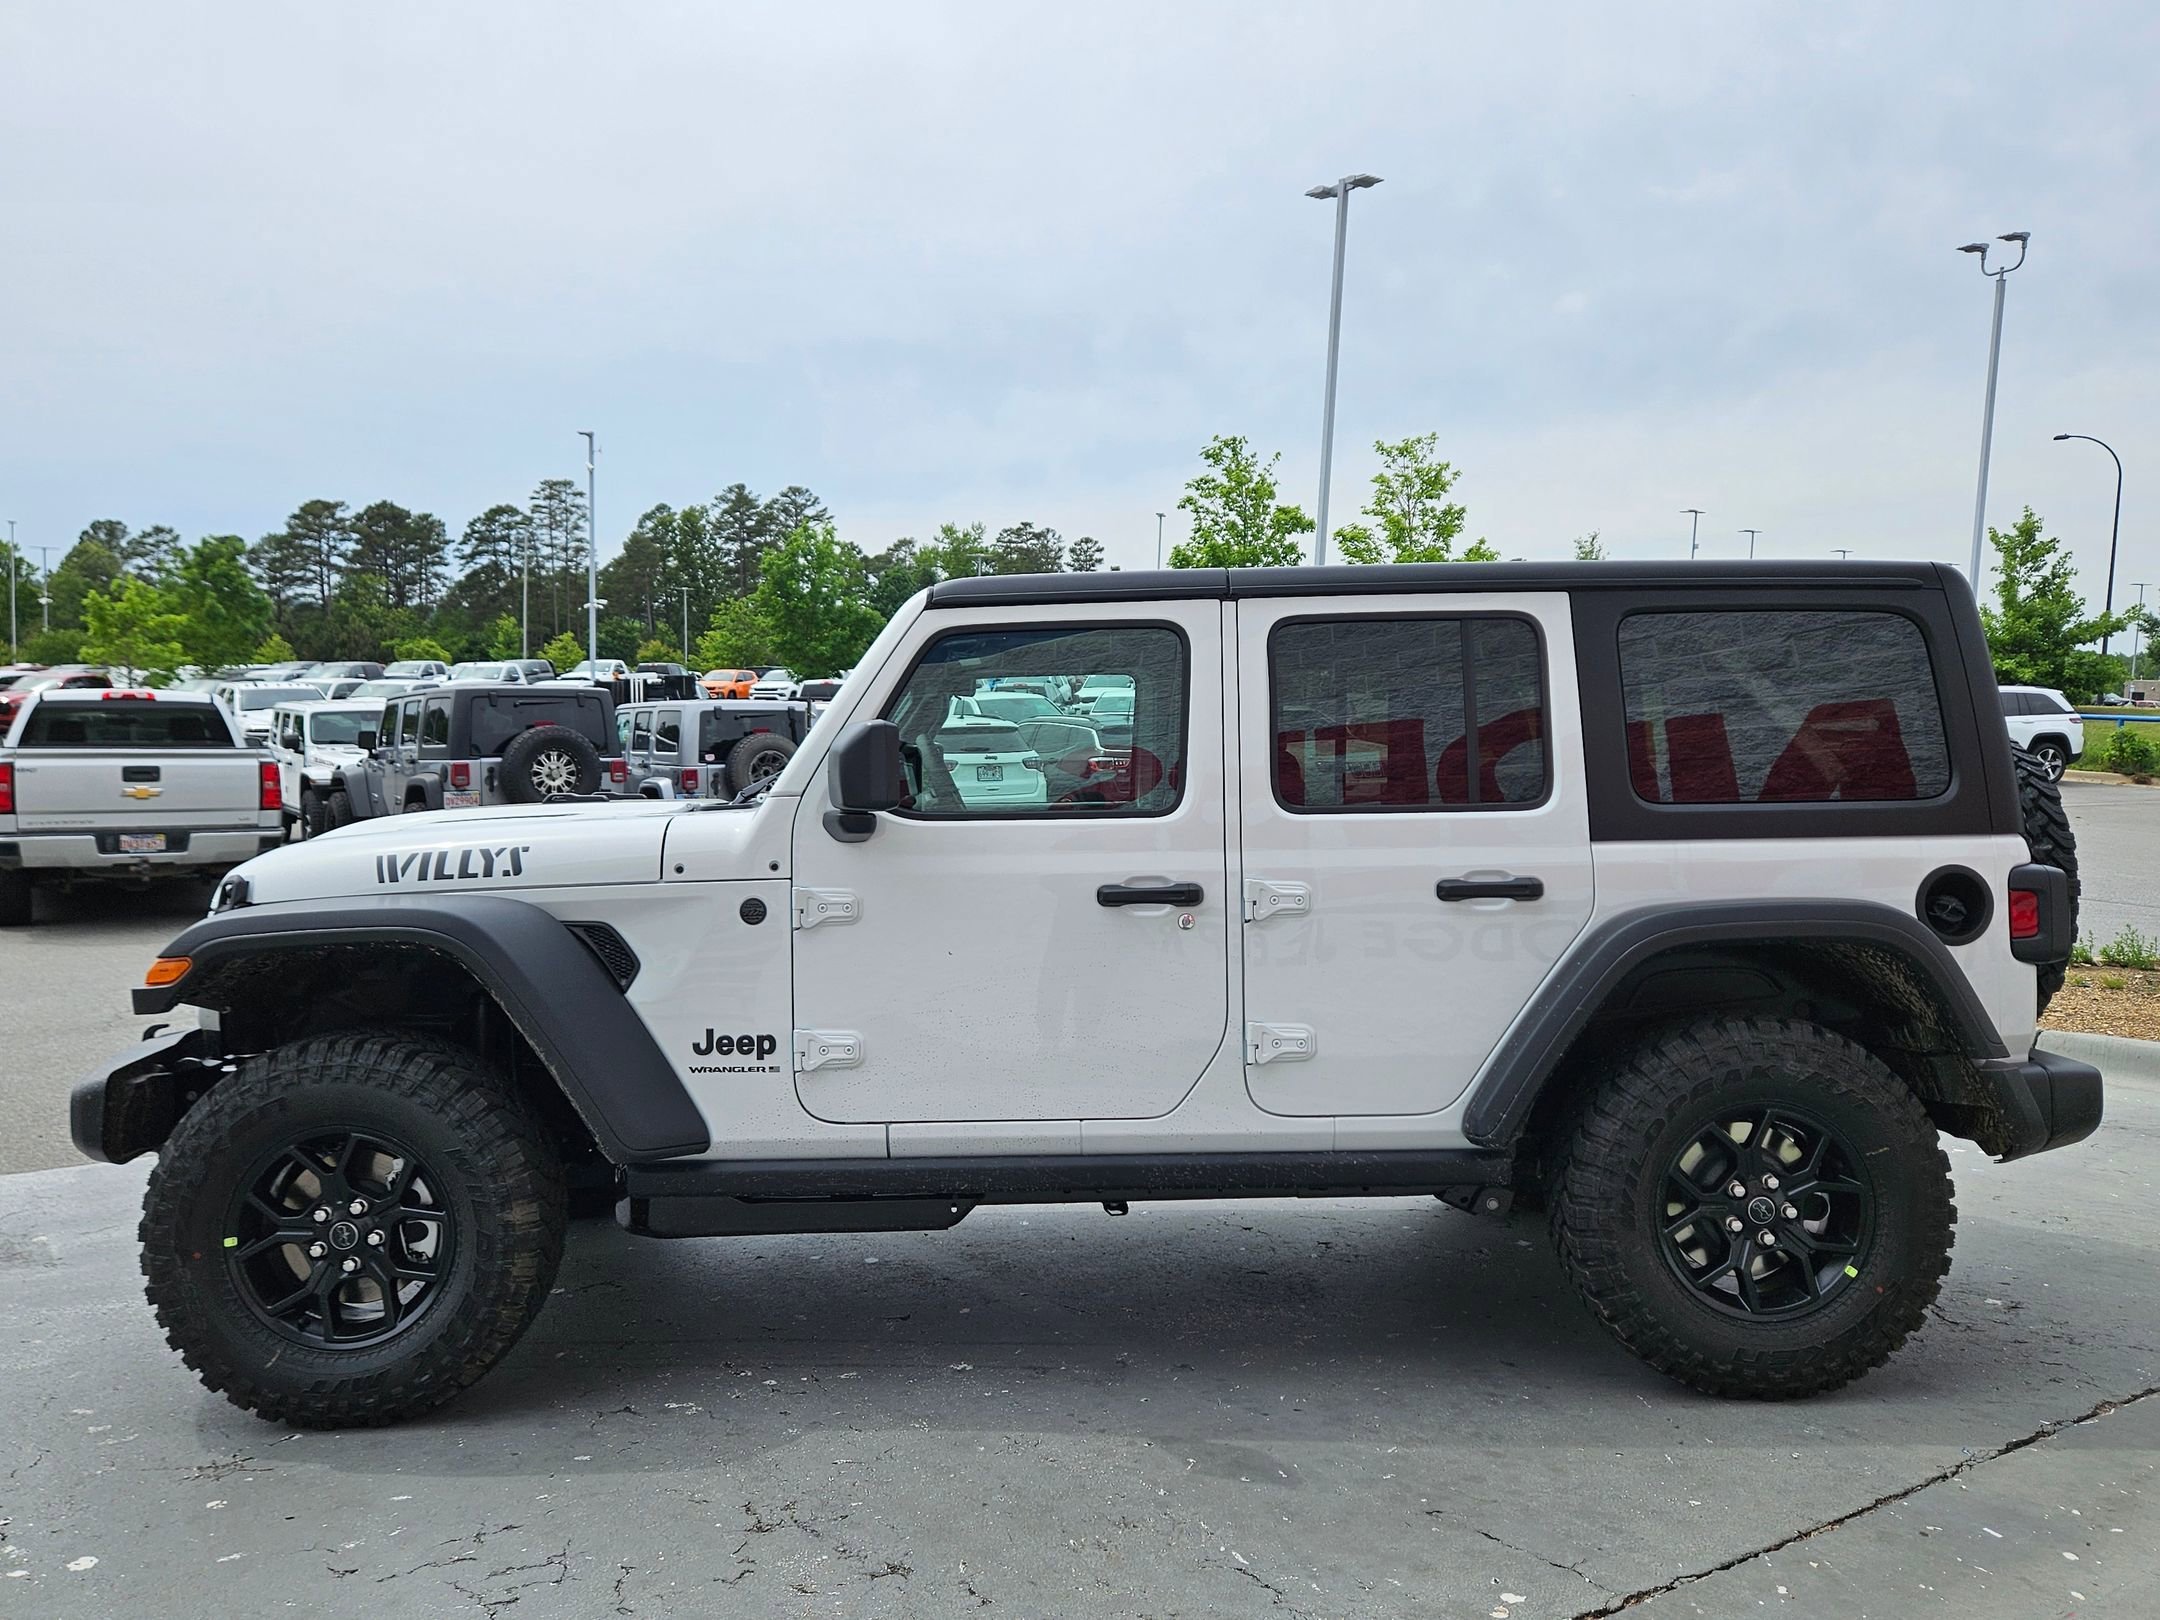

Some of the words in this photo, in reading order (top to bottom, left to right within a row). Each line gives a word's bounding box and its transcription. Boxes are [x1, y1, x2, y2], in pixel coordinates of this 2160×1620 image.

[376, 846, 530, 884] WILLYS
[692, 1028, 776, 1060] Jeep
[689, 1066, 766, 1074] WRANGLER
